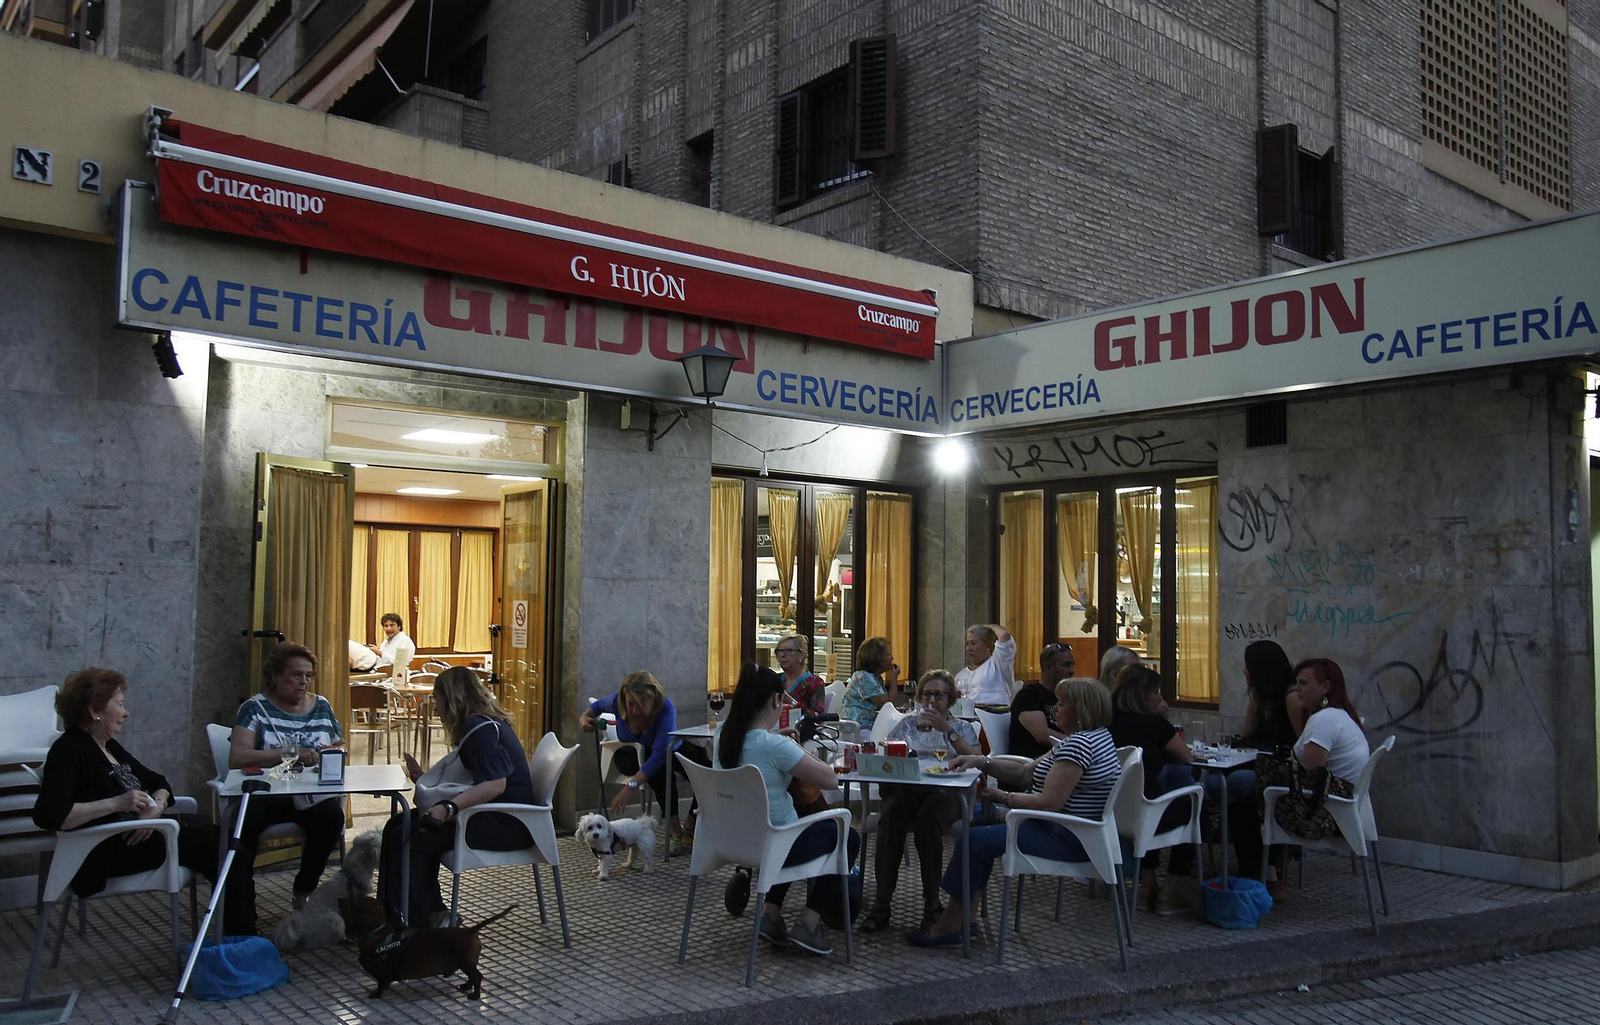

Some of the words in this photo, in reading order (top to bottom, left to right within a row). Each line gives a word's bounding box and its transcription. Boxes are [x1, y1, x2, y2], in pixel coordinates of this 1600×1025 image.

[81, 161, 100, 192] 2
[196, 170, 325, 215] Cruzcampo
[570, 255, 596, 283] G.
[609, 266, 687, 302] HIJÓN
[131, 268, 428, 352] CAFETERÍA
[857, 304, 921, 334] Cruzcampo
[1362, 295, 1600, 365] CAFETERÍA
[756, 369, 940, 425] CERVECERÍA
[949, 373, 1102, 424] CERVECERÍA
[375, 940, 402, 954] CACHITO
